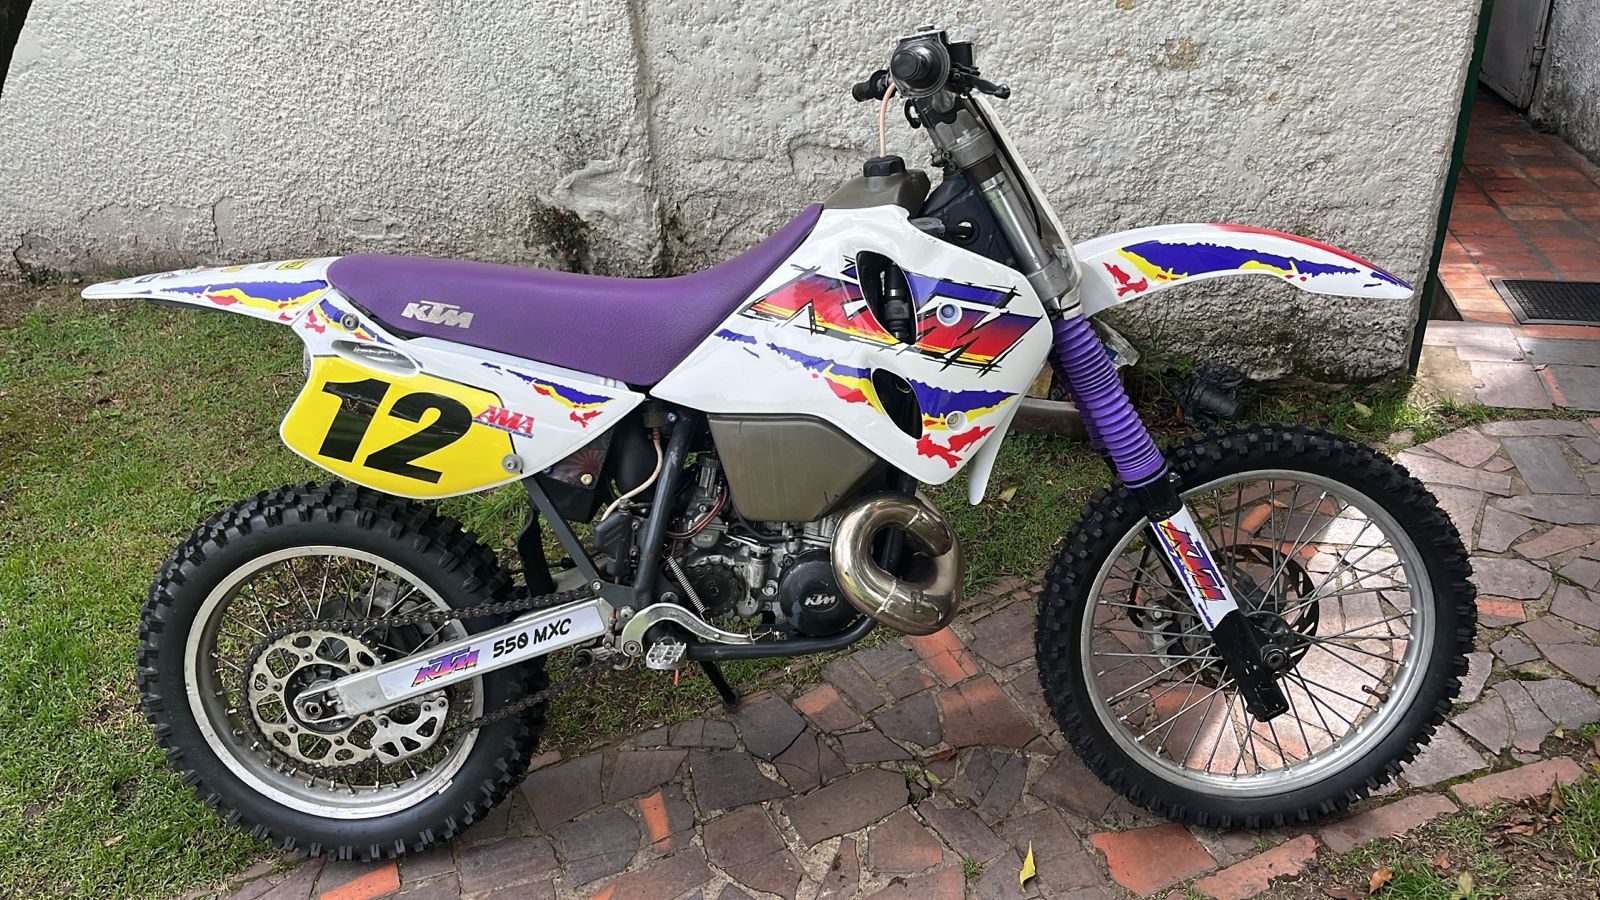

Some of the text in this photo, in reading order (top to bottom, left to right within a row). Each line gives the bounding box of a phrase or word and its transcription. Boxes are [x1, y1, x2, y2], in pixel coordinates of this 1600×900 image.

[401, 300, 474, 328] KTM
[319, 378, 473, 483] 12
[474, 404, 535, 435] AMA
[1158, 521, 1228, 603] KTM
[805, 593, 836, 606] KTM
[411, 618, 572, 687] KTM 550 MXC
